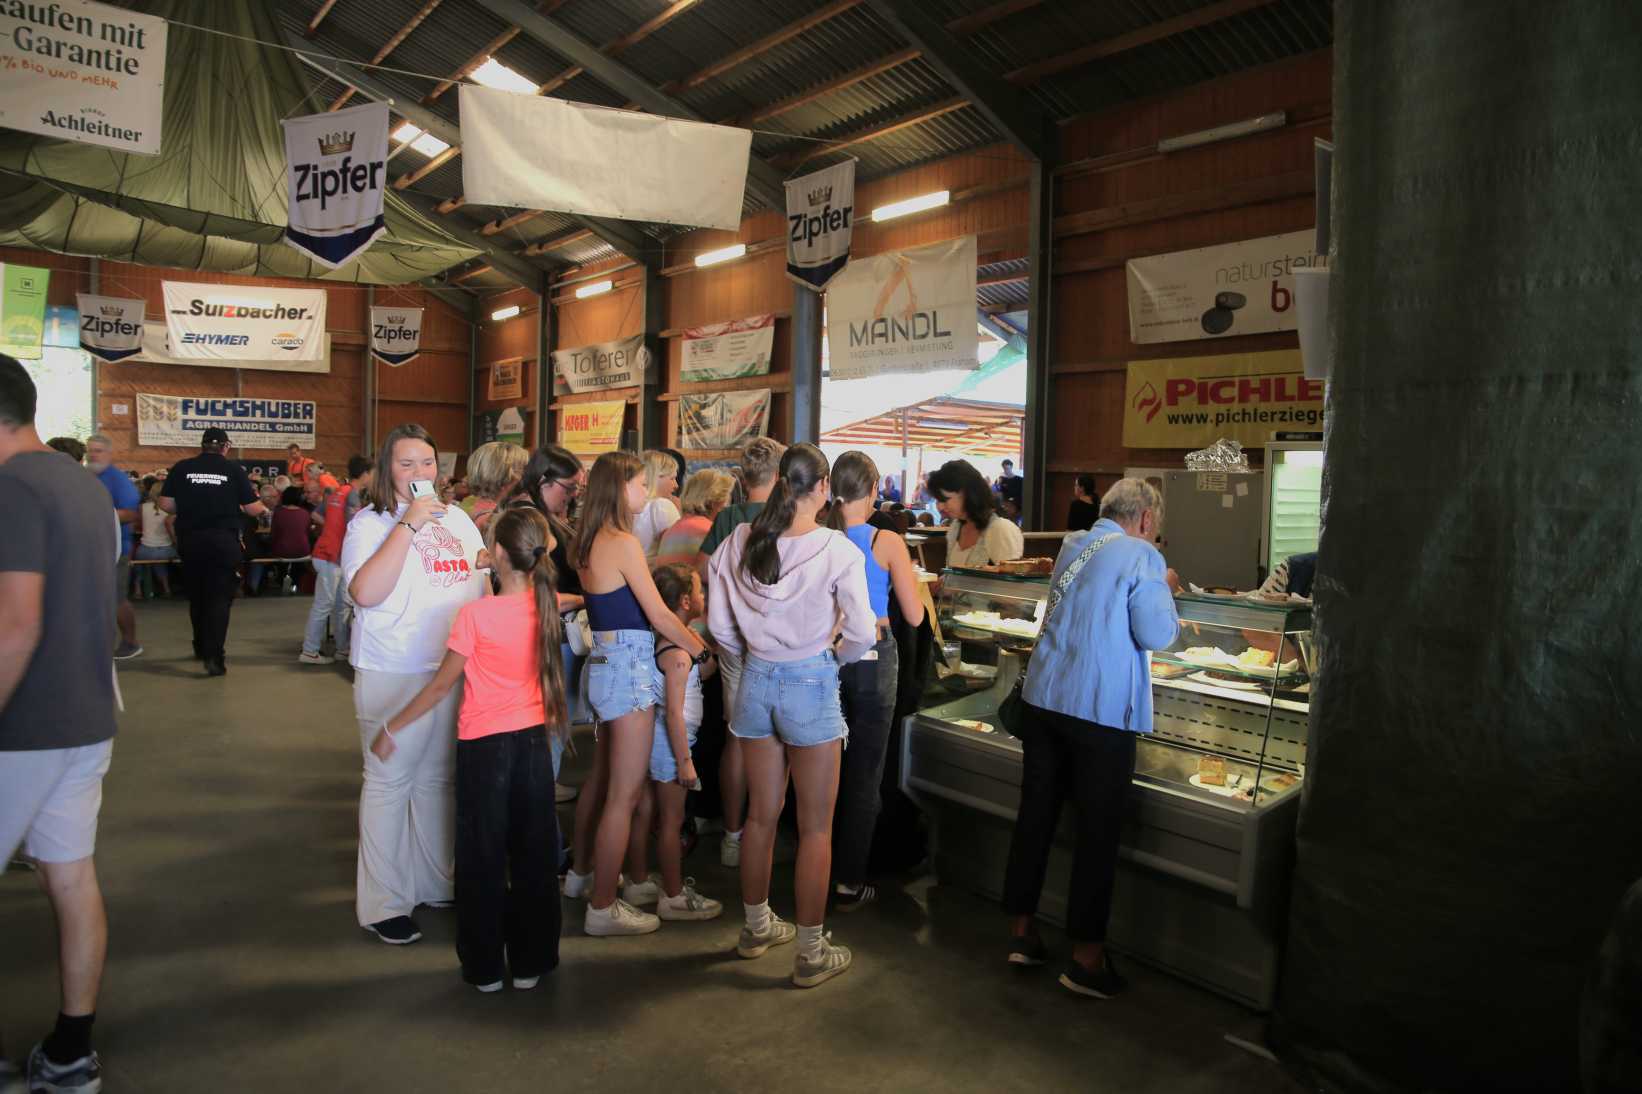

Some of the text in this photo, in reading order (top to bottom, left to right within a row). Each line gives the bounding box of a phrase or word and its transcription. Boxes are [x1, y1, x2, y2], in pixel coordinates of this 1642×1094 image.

[101, 23, 146, 50] mit
[21, 59, 45, 74] BIO
[48, 68, 79, 80] UND
[82, 75, 120, 91] MEHR
[40, 110, 143, 143] Achleitner
[293, 155, 384, 211] Zipfer
[789, 204, 853, 248] Zipfer
[1215, 249, 1328, 285] naturstein
[189, 299, 308, 321] Sulzbacher
[81, 314, 143, 338] Zipfer
[374, 324, 419, 344] Zipfer
[849, 310, 953, 348] MANDL
[195, 333, 250, 346] HYMER
[181, 399, 314, 419] FUCHSHUBER
[185, 418, 309, 433] AGRARHANDEL GmbH
[186, 473, 228, 482] FEUERWEHR
